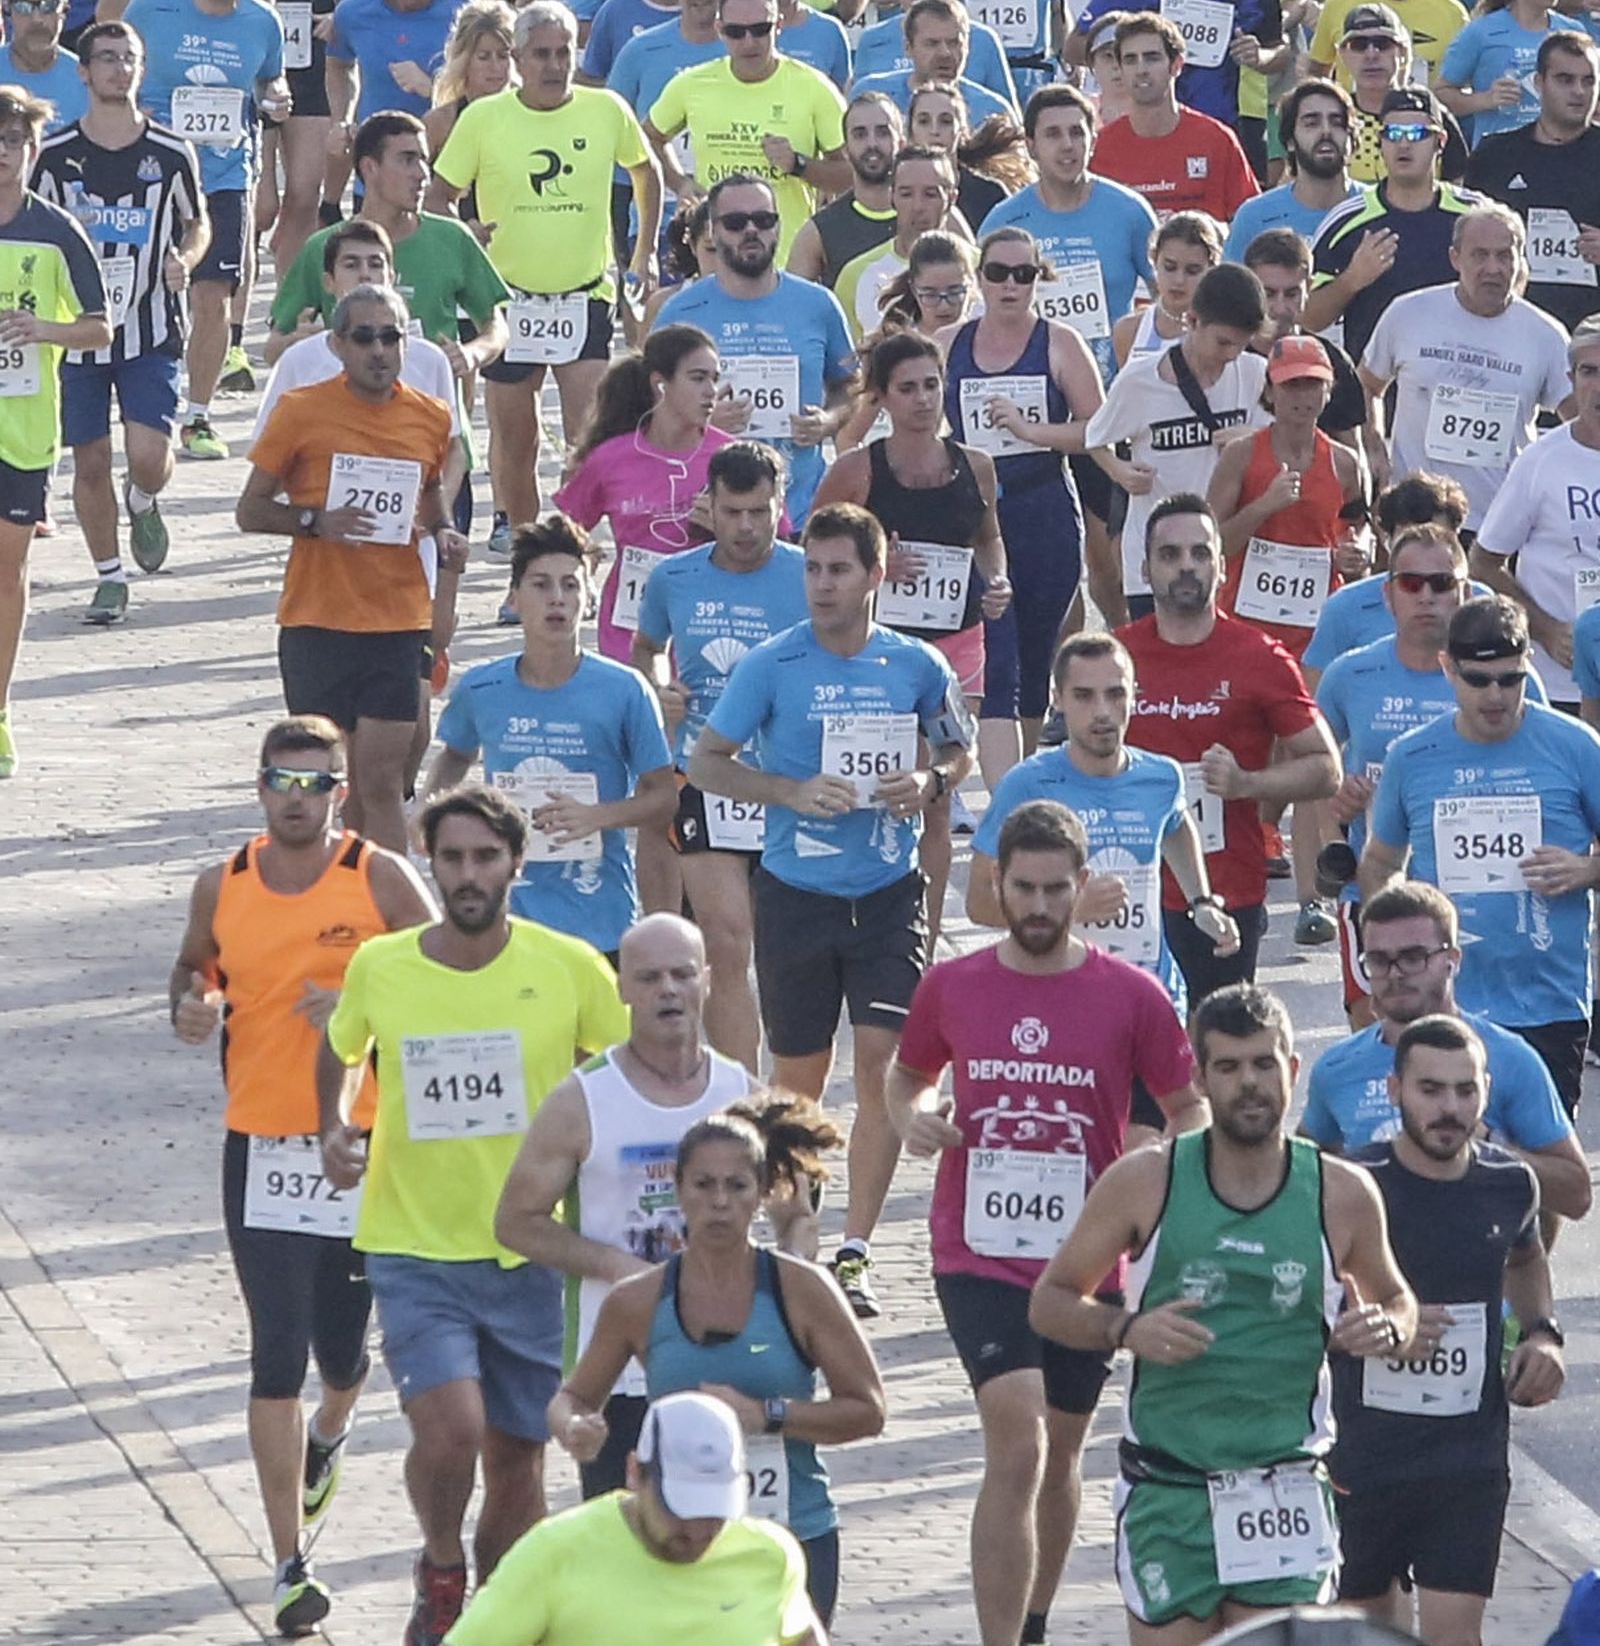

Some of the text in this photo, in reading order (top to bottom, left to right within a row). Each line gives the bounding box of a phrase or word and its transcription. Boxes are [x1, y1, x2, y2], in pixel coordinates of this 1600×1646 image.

[978, 4, 1027, 25] 1126
[184, 113, 230, 132] 2372
[1531, 237, 1580, 259] 1843
[519, 318, 573, 340] 9240
[1442, 414, 1501, 442] 8792
[345, 487, 402, 514] 2768
[1256, 572, 1316, 600] 6618
[839, 752, 902, 777] 3561
[1453, 833, 1525, 860] 3548
[423, 1071, 504, 1102] 4194
[968, 1059, 1096, 1089] DEPORTIADA
[984, 1190, 1064, 1223] 6046
[1236, 1507, 1311, 1542] 6686
